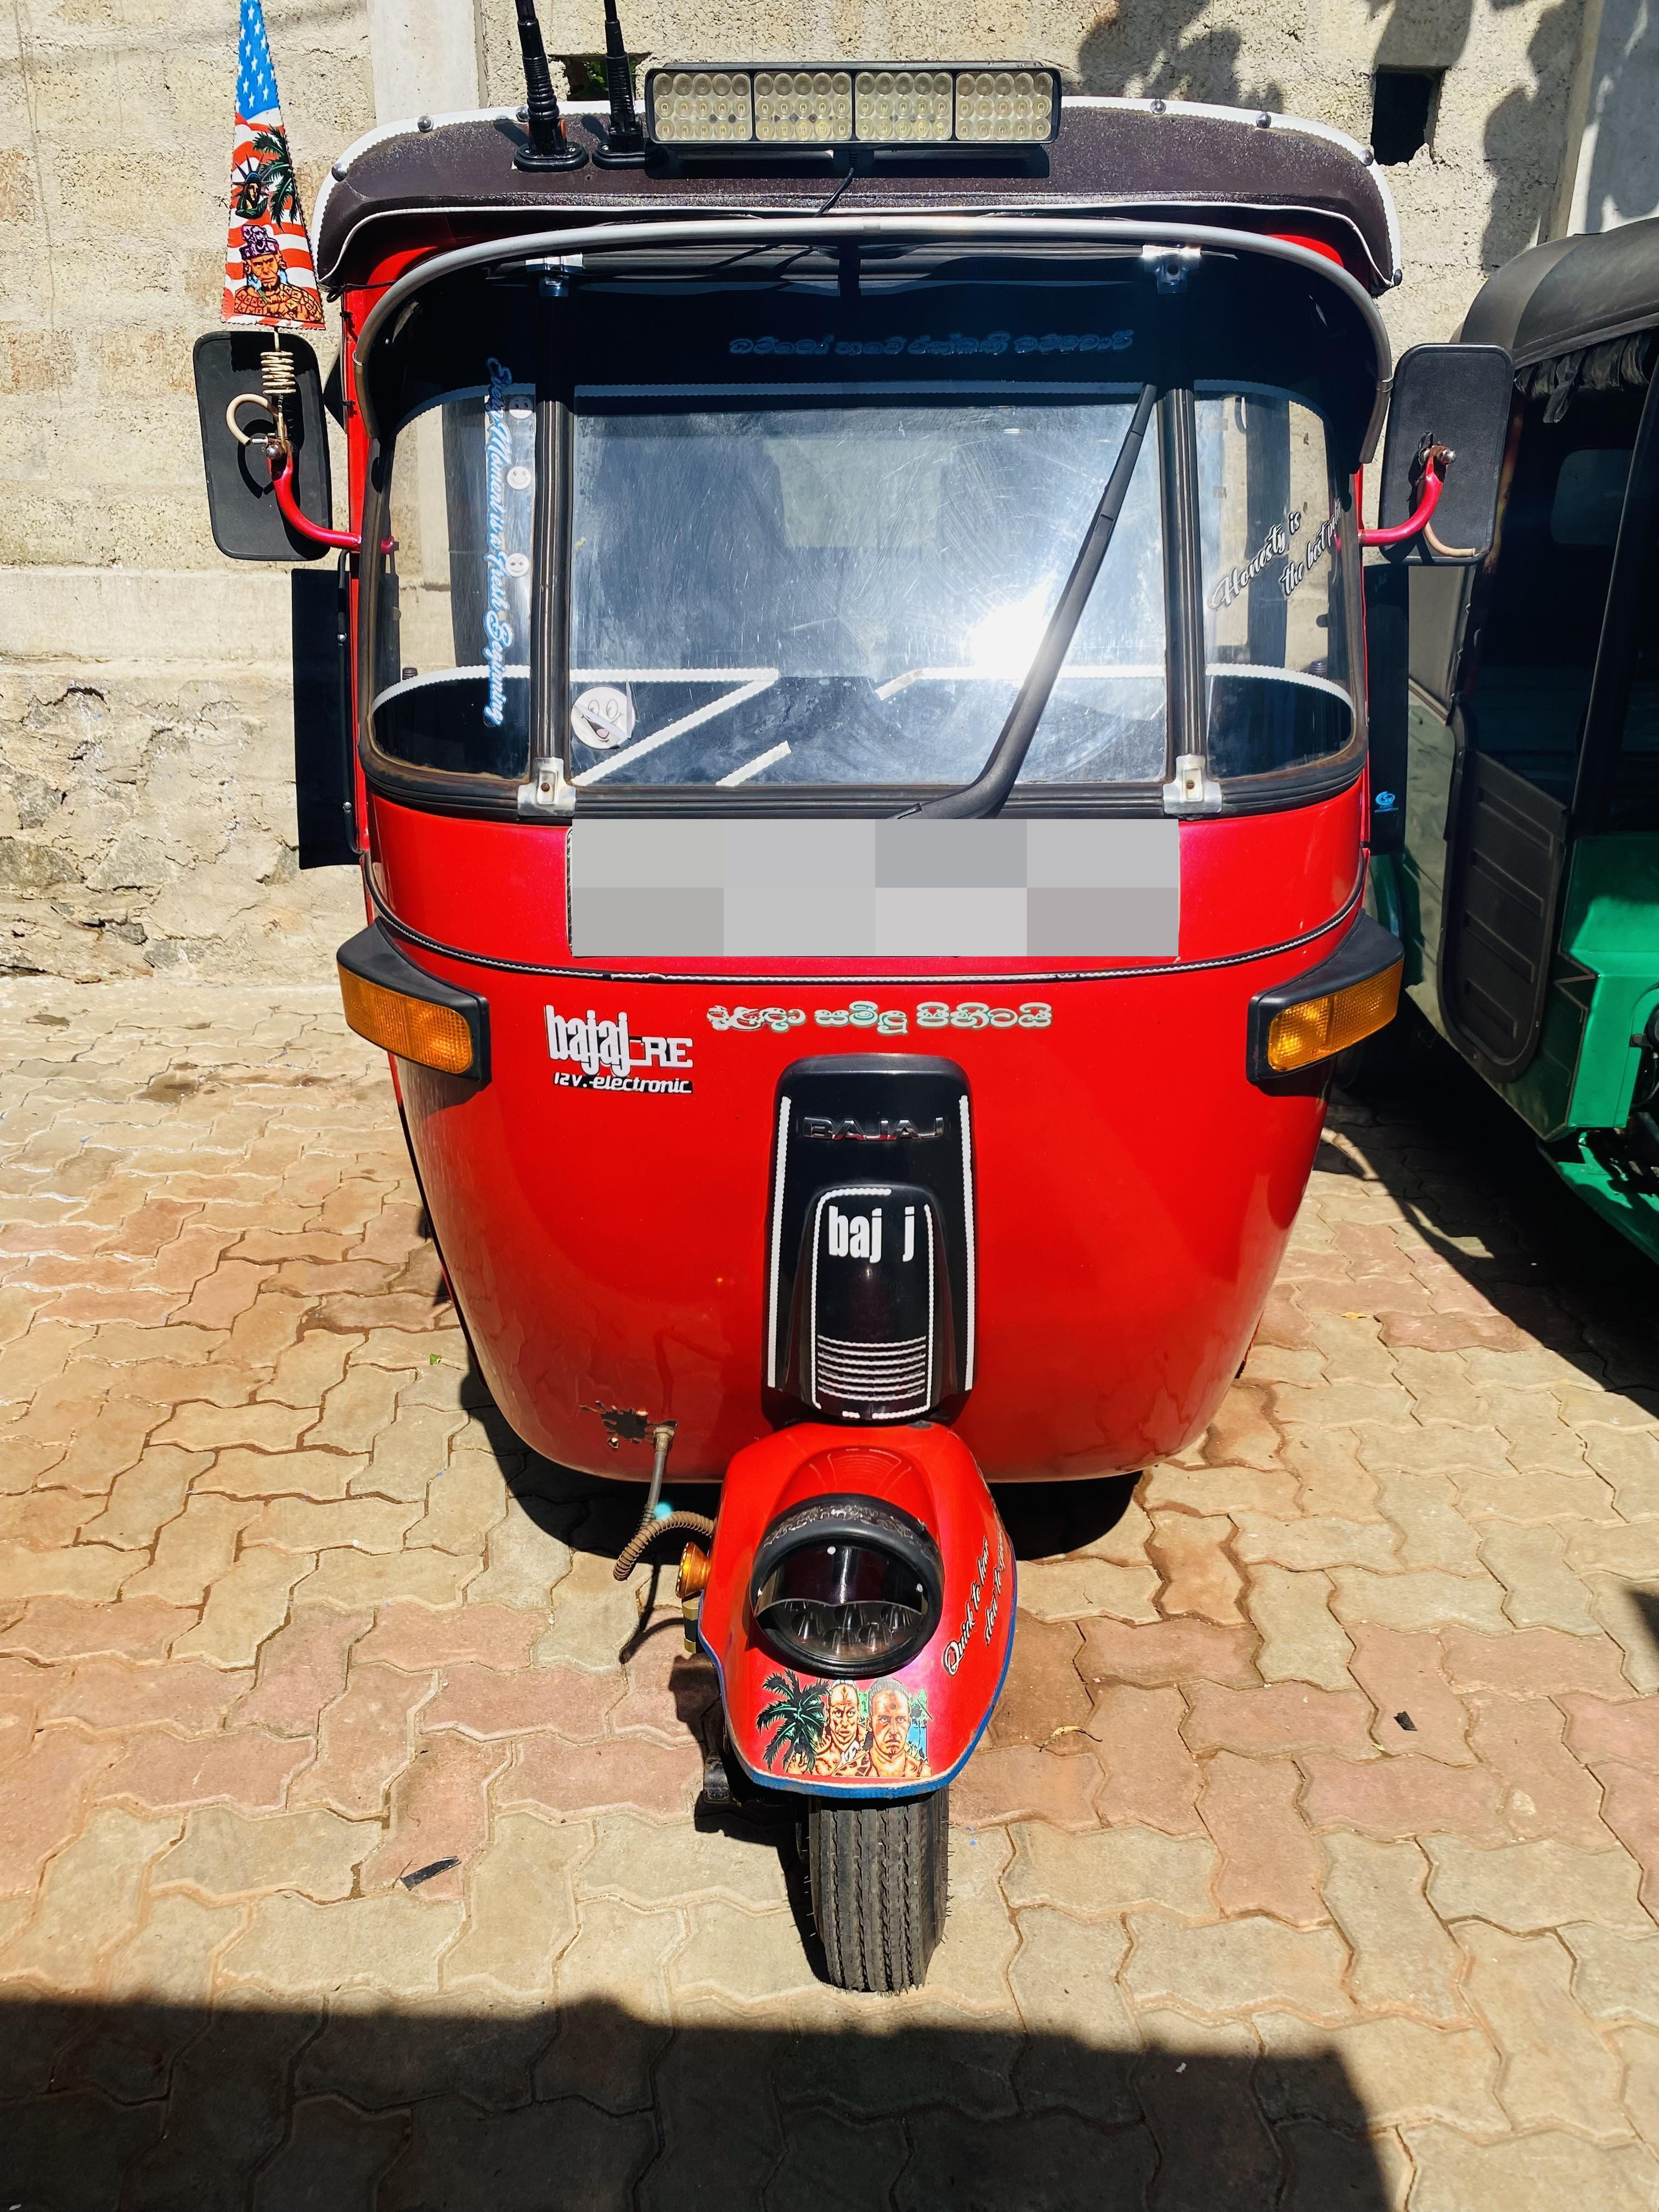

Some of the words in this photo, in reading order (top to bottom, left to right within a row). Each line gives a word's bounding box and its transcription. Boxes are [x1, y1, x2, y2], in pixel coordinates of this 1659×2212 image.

[484, 358, 512, 422] Every
[485, 422, 511, 515] Moment
[489, 512, 505, 534] is
[489, 532, 503, 550] a
[484, 550, 511, 612] Fresh
[1209, 524, 1286, 610] Honesty
[1289, 511, 1302, 534] is
[1278, 561, 1305, 596] the
[1306, 522, 1328, 571] best
[483, 609, 513, 727] Beginning
[544, 1005, 630, 1077] bajaj
[916, 1001, 1053, 1029] පිහිටයි
[804, 1116, 944, 1141] BAJAJ
